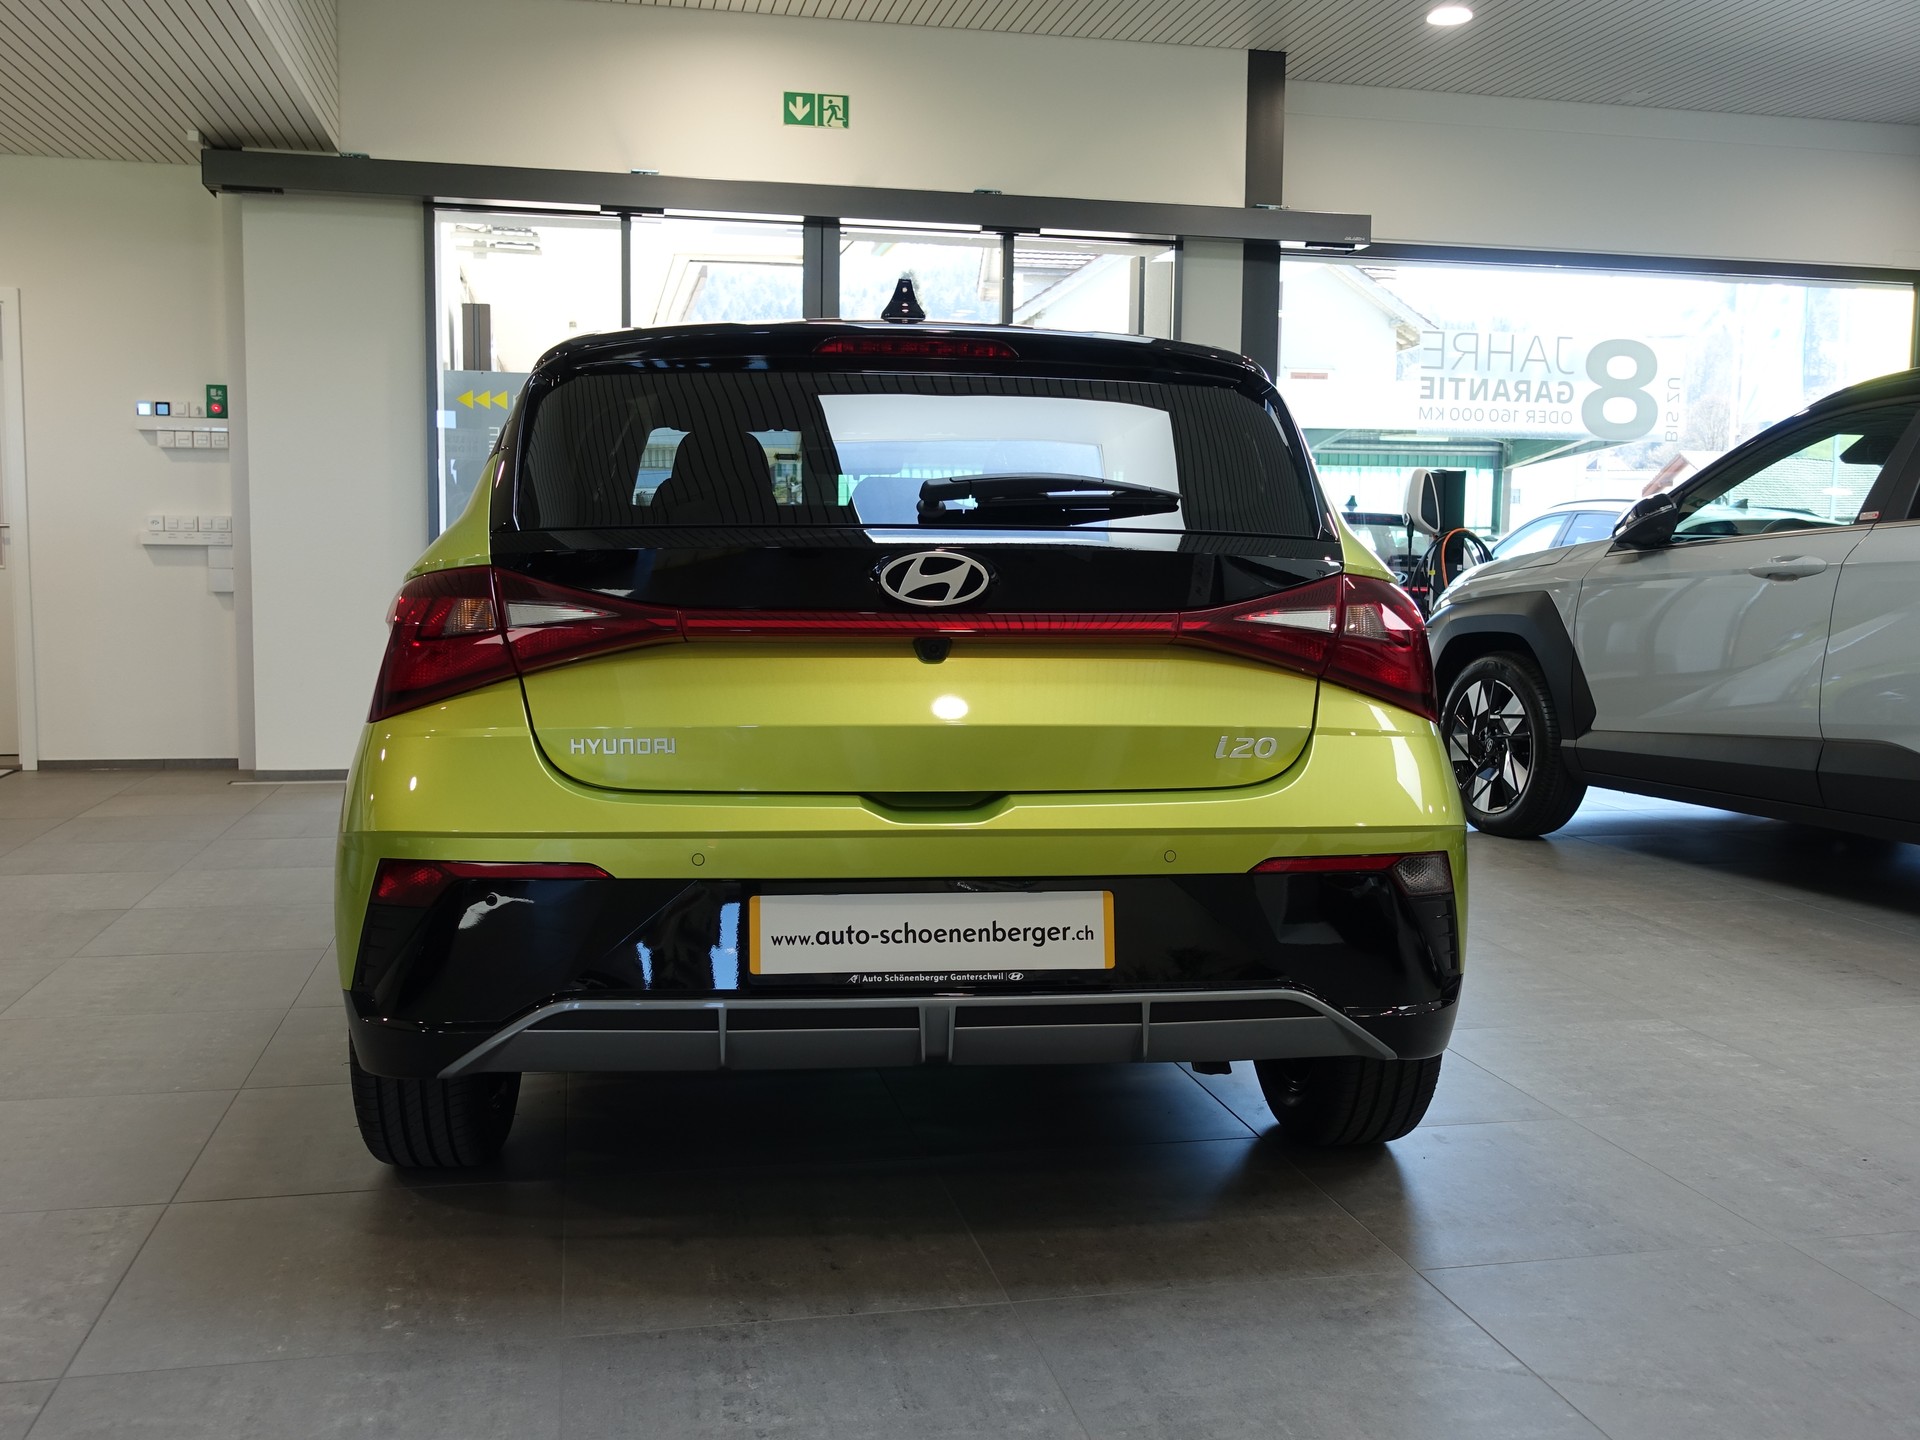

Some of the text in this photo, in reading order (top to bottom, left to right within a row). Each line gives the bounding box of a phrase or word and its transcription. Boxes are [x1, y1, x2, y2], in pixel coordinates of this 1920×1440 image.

[569, 737, 677, 755] HYUNDAI
[1214, 735, 1278, 759] i20
[770, 920, 1095, 948] www.auto-schoenenberger.ch
[862, 972, 1004, 983] Auto Schönenberger Ganterschwil
